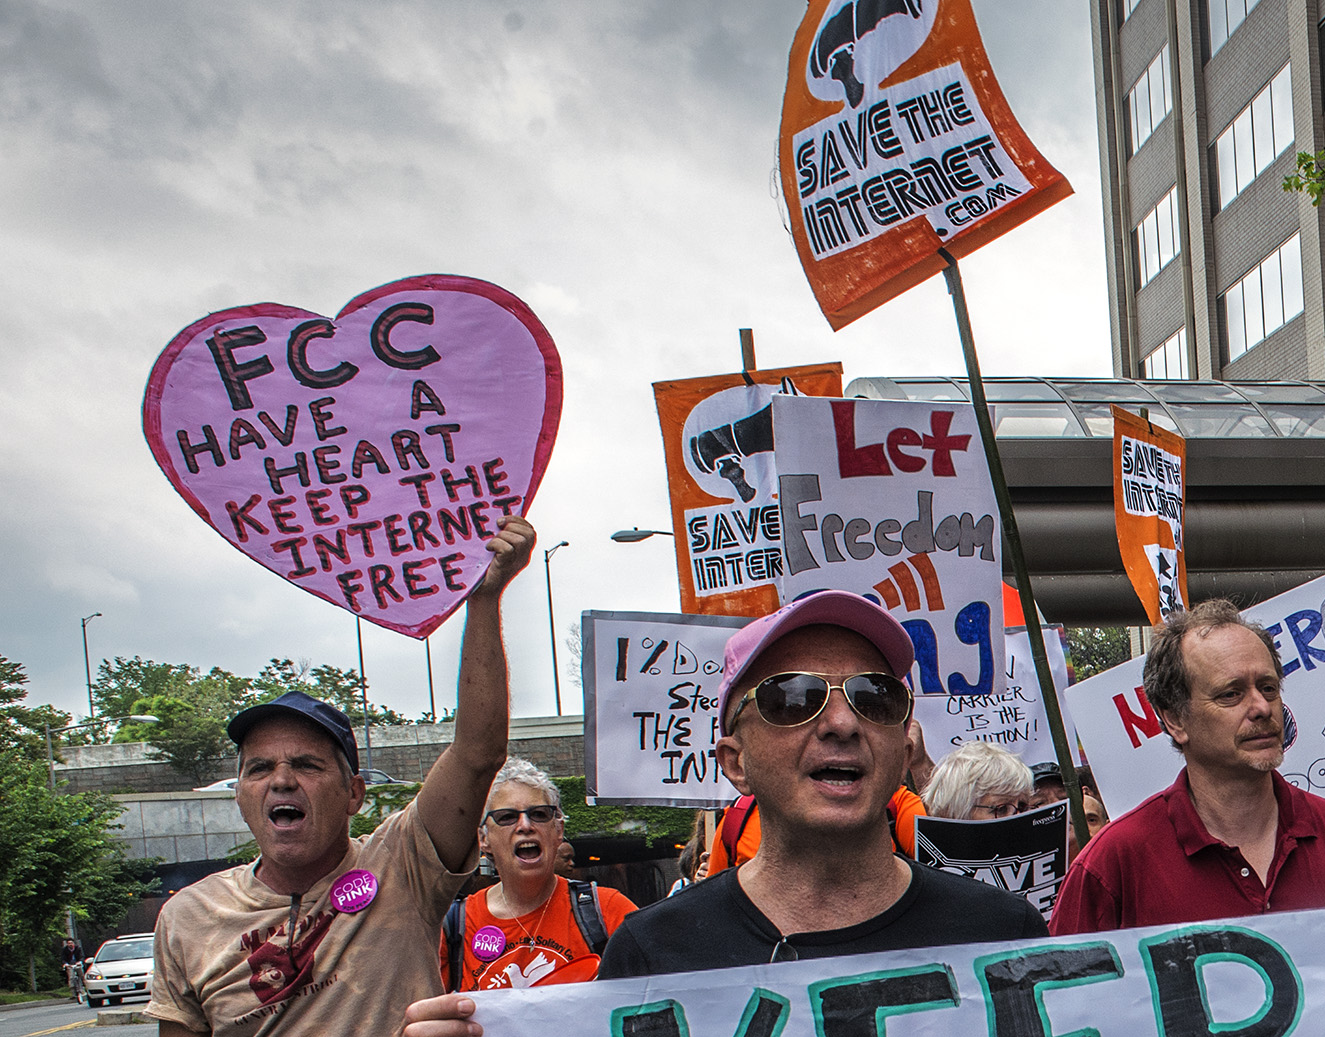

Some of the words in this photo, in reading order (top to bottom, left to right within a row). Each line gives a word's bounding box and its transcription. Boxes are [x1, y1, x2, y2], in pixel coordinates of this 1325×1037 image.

[795, 100, 904, 198] SAVE
[897, 80, 974, 144] THE
[804, 134, 1005, 255] INTERNET
[936, 183, 1022, 236] .COM
[205, 302, 441, 410] FCC
[176, 397, 347, 473] HAVE
[411, 379, 446, 420] A
[830, 401, 972, 479] Let
[265, 423, 461, 496] HEART
[1123, 440, 1165, 484] SAVE
[225, 485, 371, 541] KEEP
[399, 457, 509, 508] THE
[779, 474, 996, 575] Freedom
[272, 495, 522, 579] INTERNET
[688, 504, 780, 553] SAVE
[337, 553, 467, 612] FREE
[693, 547, 783, 590] INTER
[632, 711, 692, 750] THE
[964, 714, 990, 732] IS
[992, 706, 1026, 724] THE
[333, 873, 371, 898] CODE
[337, 883, 373, 906] PINK
[474, 941, 499, 953] PINK
[475, 933, 503, 946] CODE
